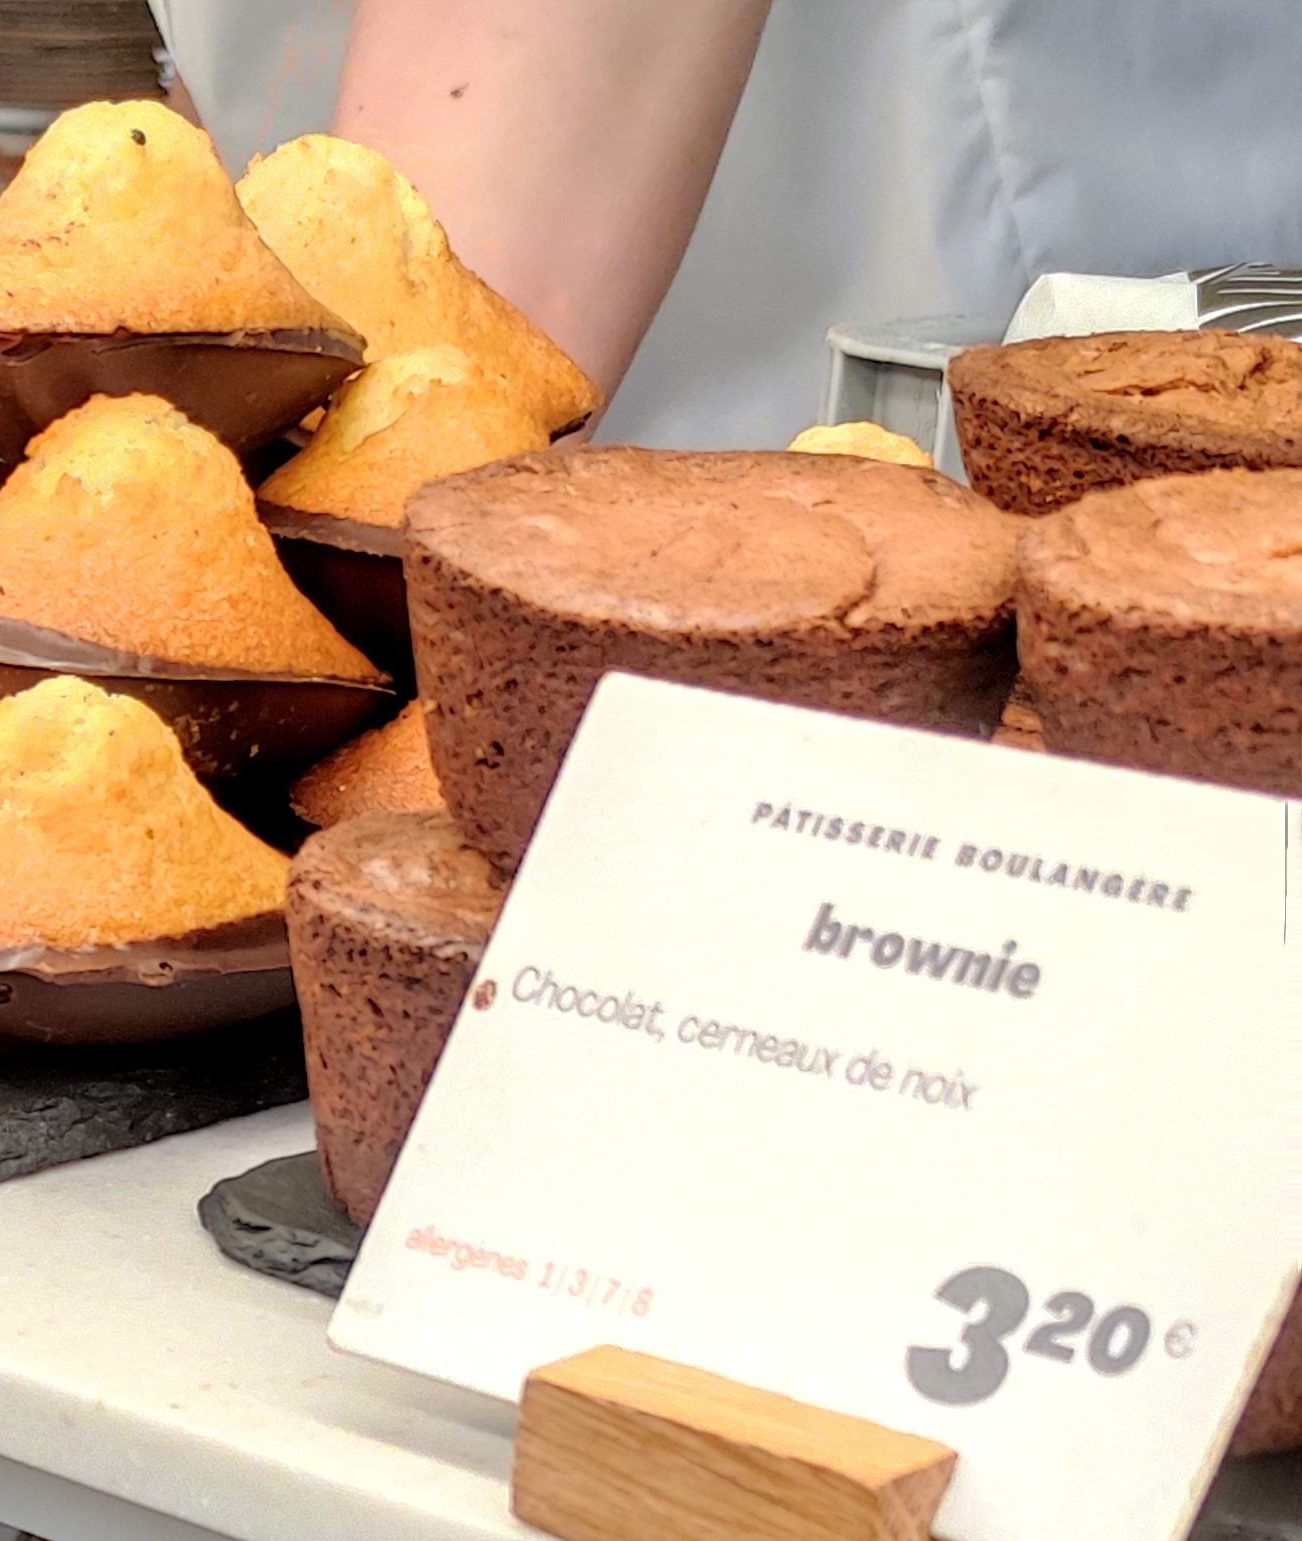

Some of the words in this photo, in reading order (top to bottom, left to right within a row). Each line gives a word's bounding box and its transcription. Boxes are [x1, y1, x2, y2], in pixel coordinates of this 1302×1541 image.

[802, 901, 1042, 999] brownie
[512, 966, 665, 1042] Chocolat,
[677, 1015, 841, 1077] cerneaux
[845, 1051, 895, 1091] de
[898, 1067, 979, 1110] noix
